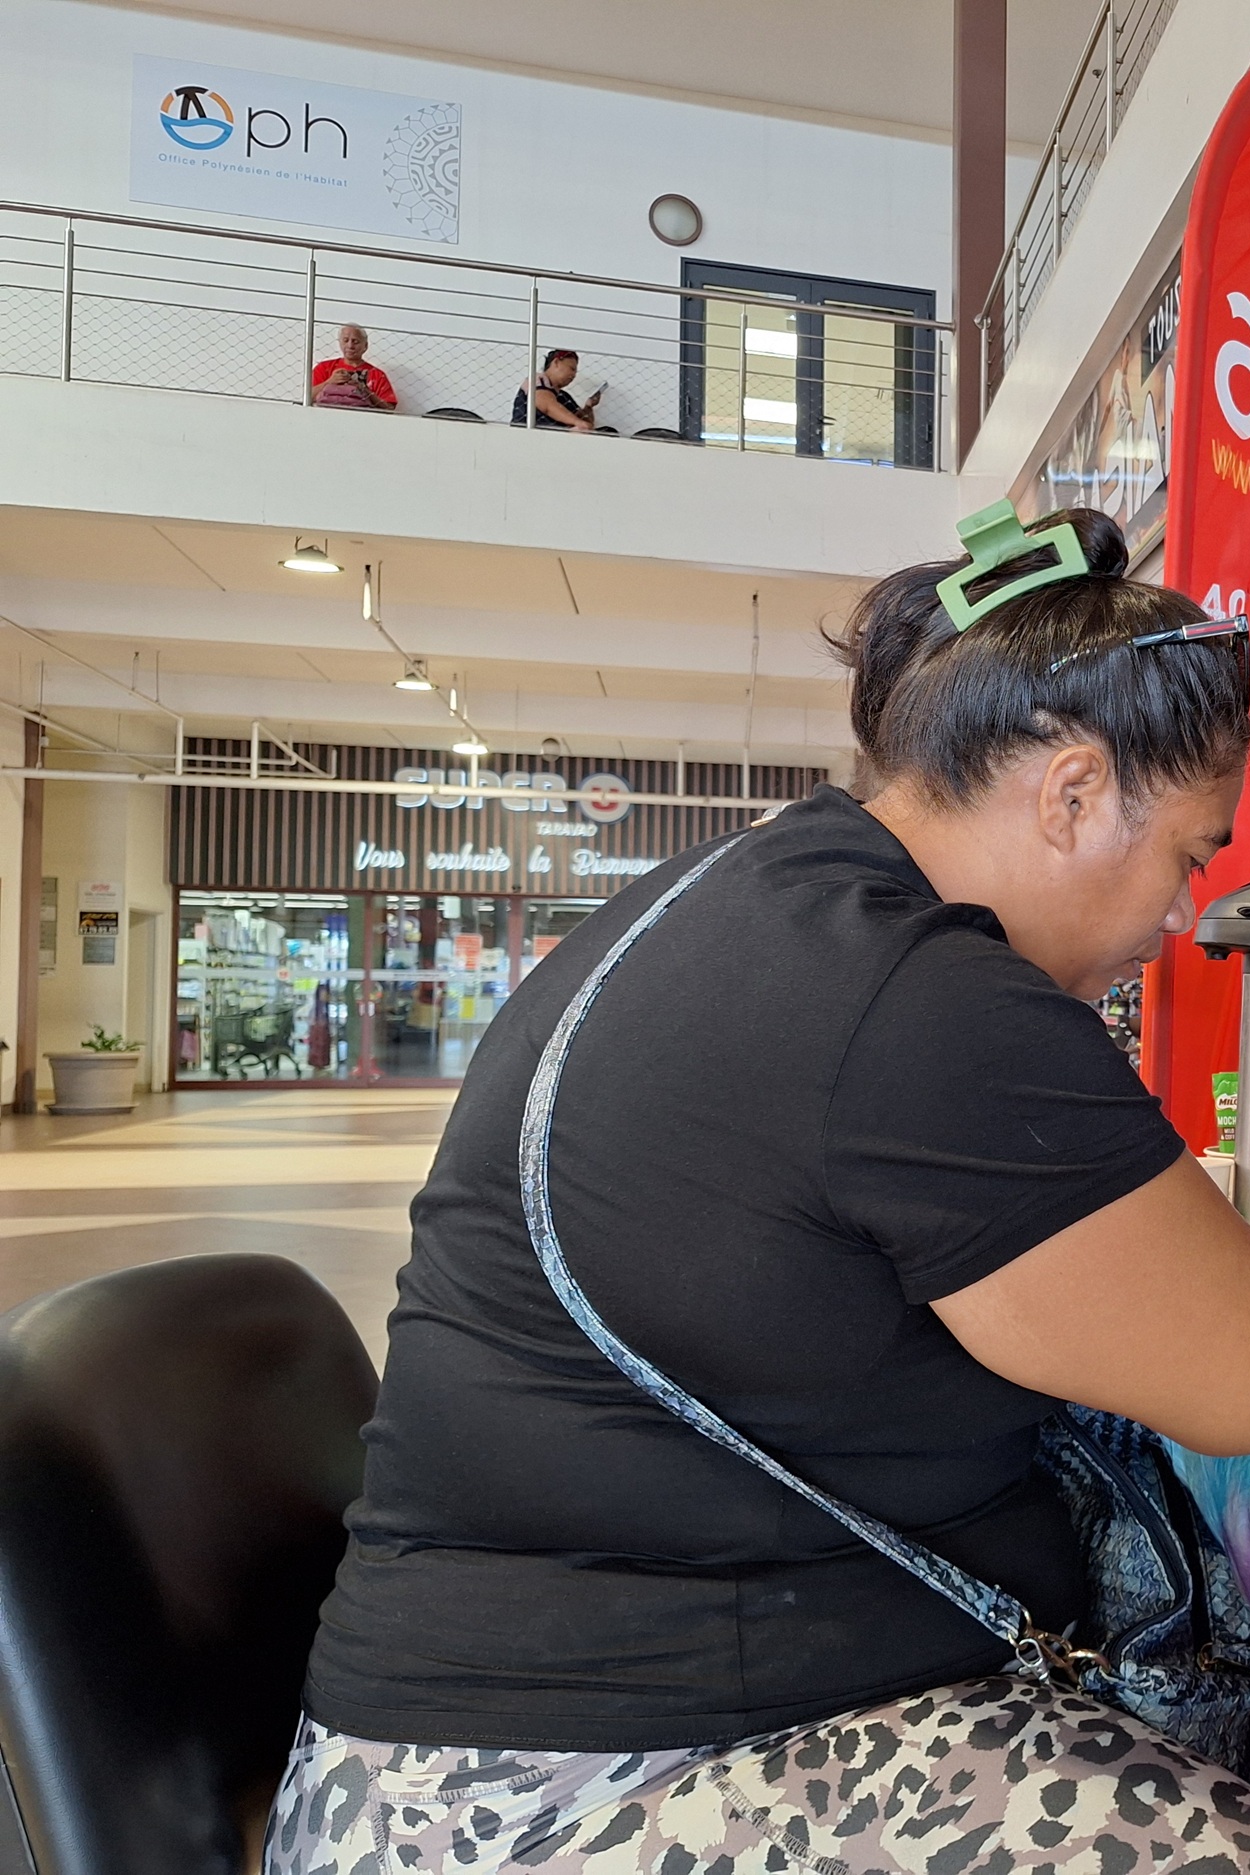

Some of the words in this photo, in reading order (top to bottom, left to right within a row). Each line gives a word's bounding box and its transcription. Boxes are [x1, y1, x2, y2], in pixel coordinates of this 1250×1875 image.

[158, 153, 196, 166] Office
[275, 170, 290, 180] de
[296, 172, 348, 188] l'Habitat
[395, 766, 568, 813] SUPER
[354, 841, 405, 871] Vous
[426, 842, 512, 872] souhaite
[528, 845, 552, 873] la
